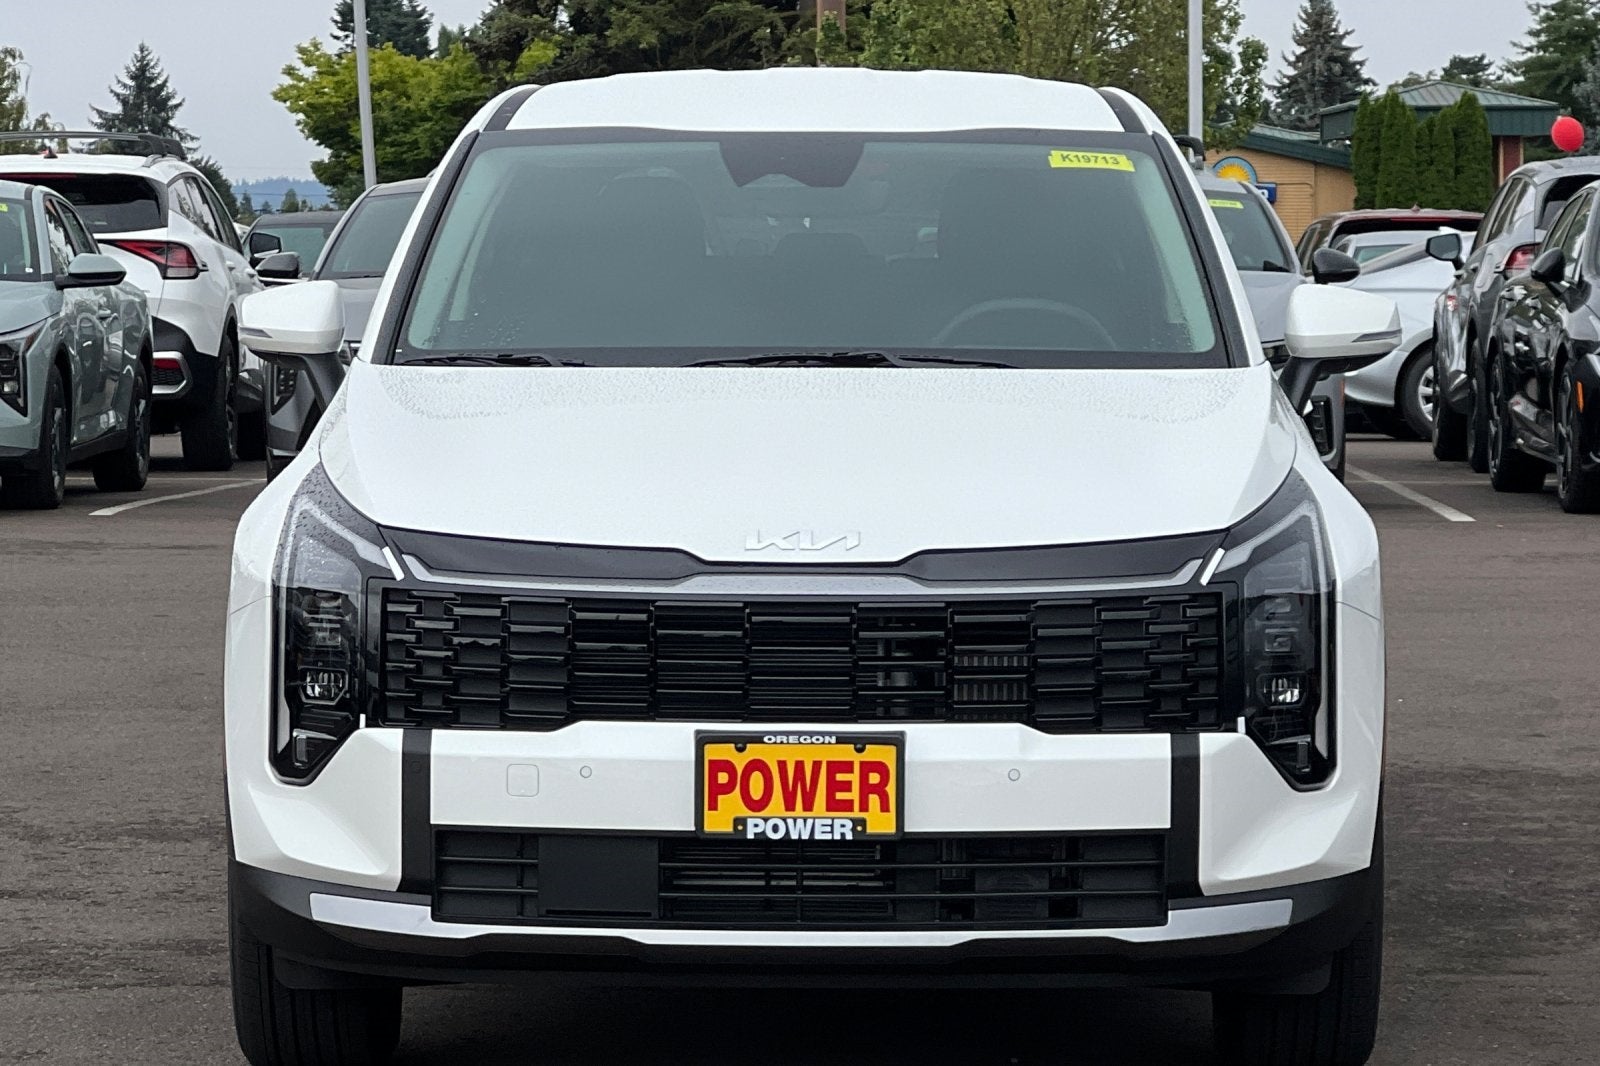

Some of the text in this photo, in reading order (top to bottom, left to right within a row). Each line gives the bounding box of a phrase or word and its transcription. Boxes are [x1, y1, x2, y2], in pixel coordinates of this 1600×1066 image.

[1060, 153, 1121, 165] K19713
[763, 735, 837, 744] OREGON
[707, 758, 891, 813] POWER
[746, 818, 853, 840] POWER
